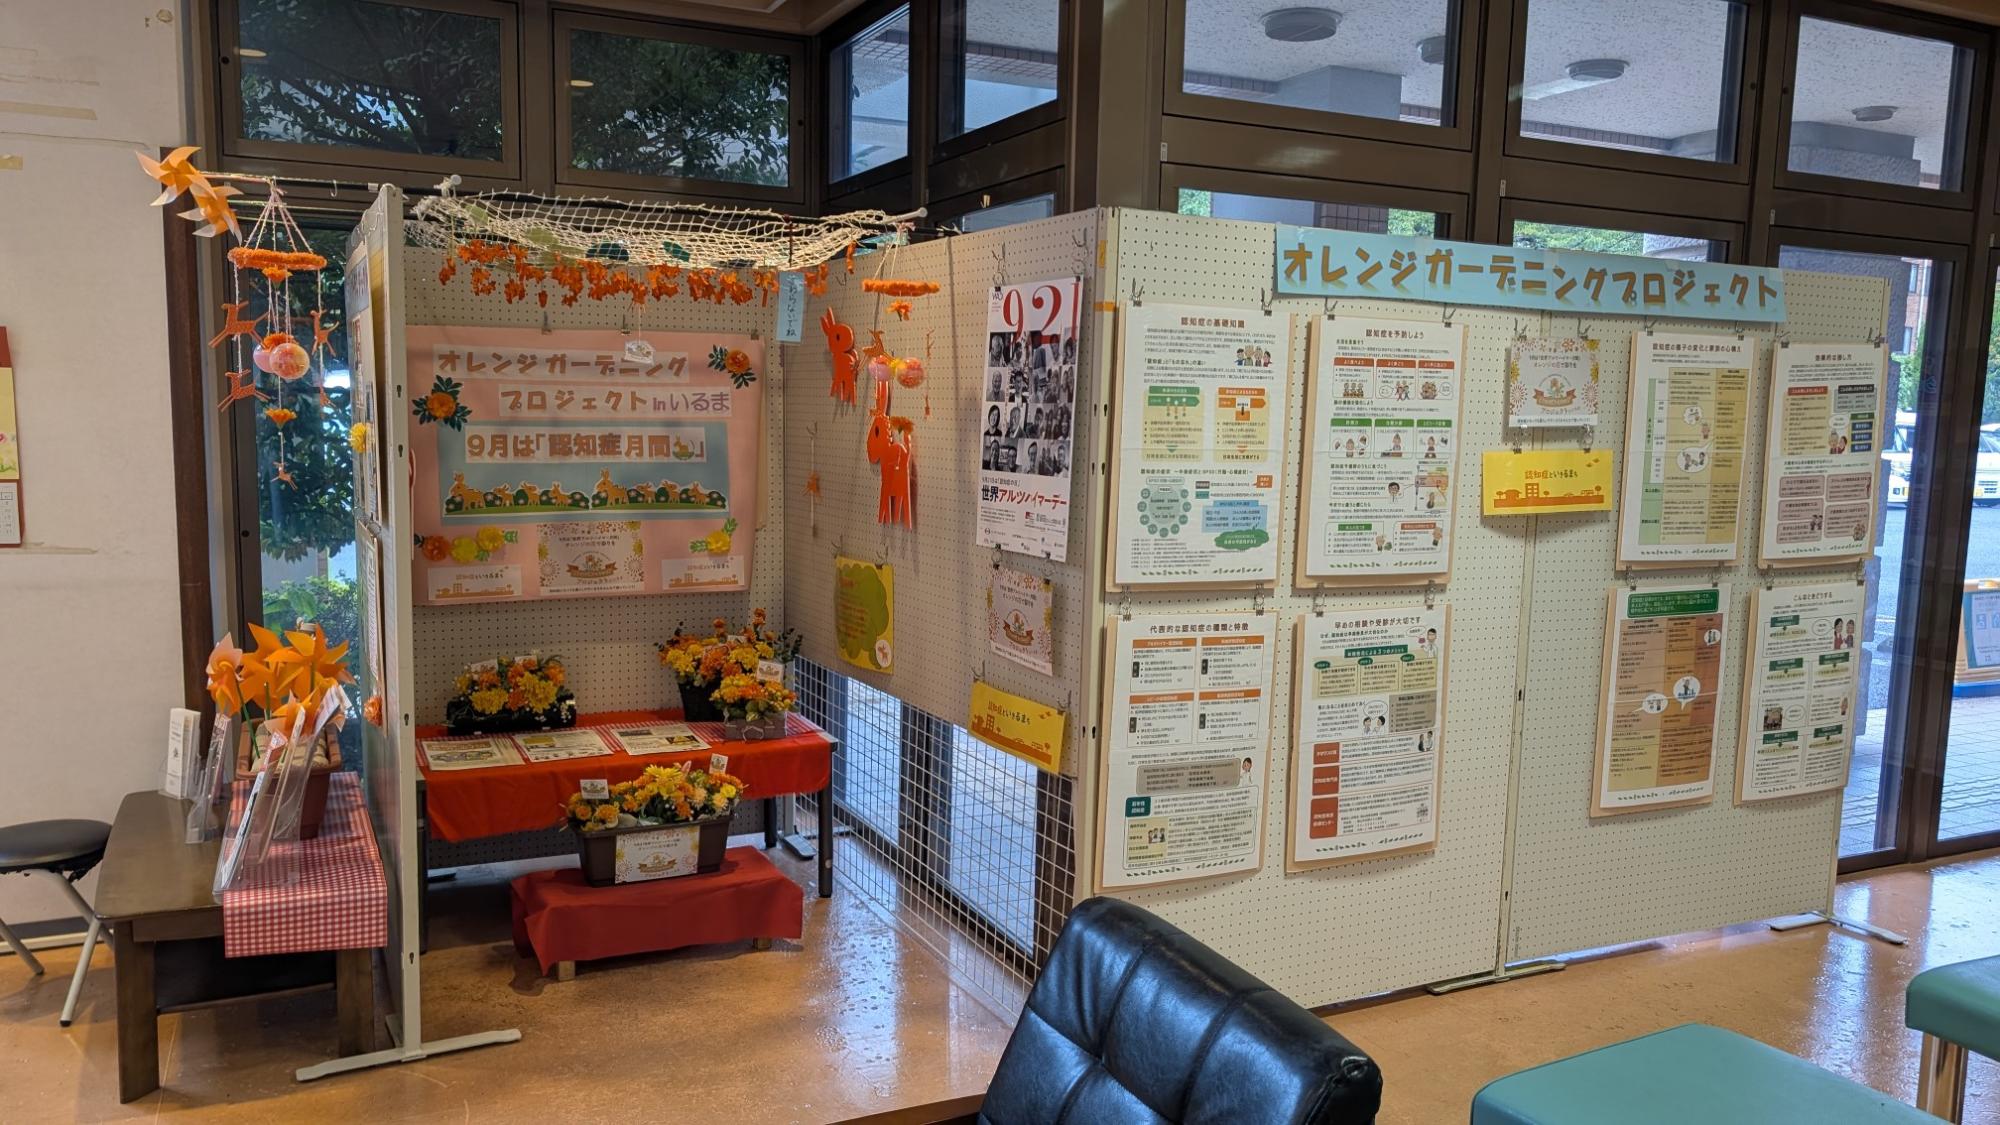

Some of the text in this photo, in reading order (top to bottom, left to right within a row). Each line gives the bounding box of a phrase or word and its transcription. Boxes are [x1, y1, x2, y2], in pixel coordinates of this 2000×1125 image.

[1284, 243, 1778, 307] オレンジガーデニングプロジェクト
[1181, 317, 1245, 328] 認知症の基礎知識
[1366, 329, 1424, 339] 認知症を予防しよう
[437, 350, 688, 377] オレンジガーデニング
[467, 433, 705, 458] 9月は「認知症月間」
[981, 484, 1067, 510] 世界アルツハイマーデー
[1150, 622, 1249, 634] 代表的な認知症の種類と特徴
[1334, 616, 1421, 629] 早めの相談や受診が大切です
